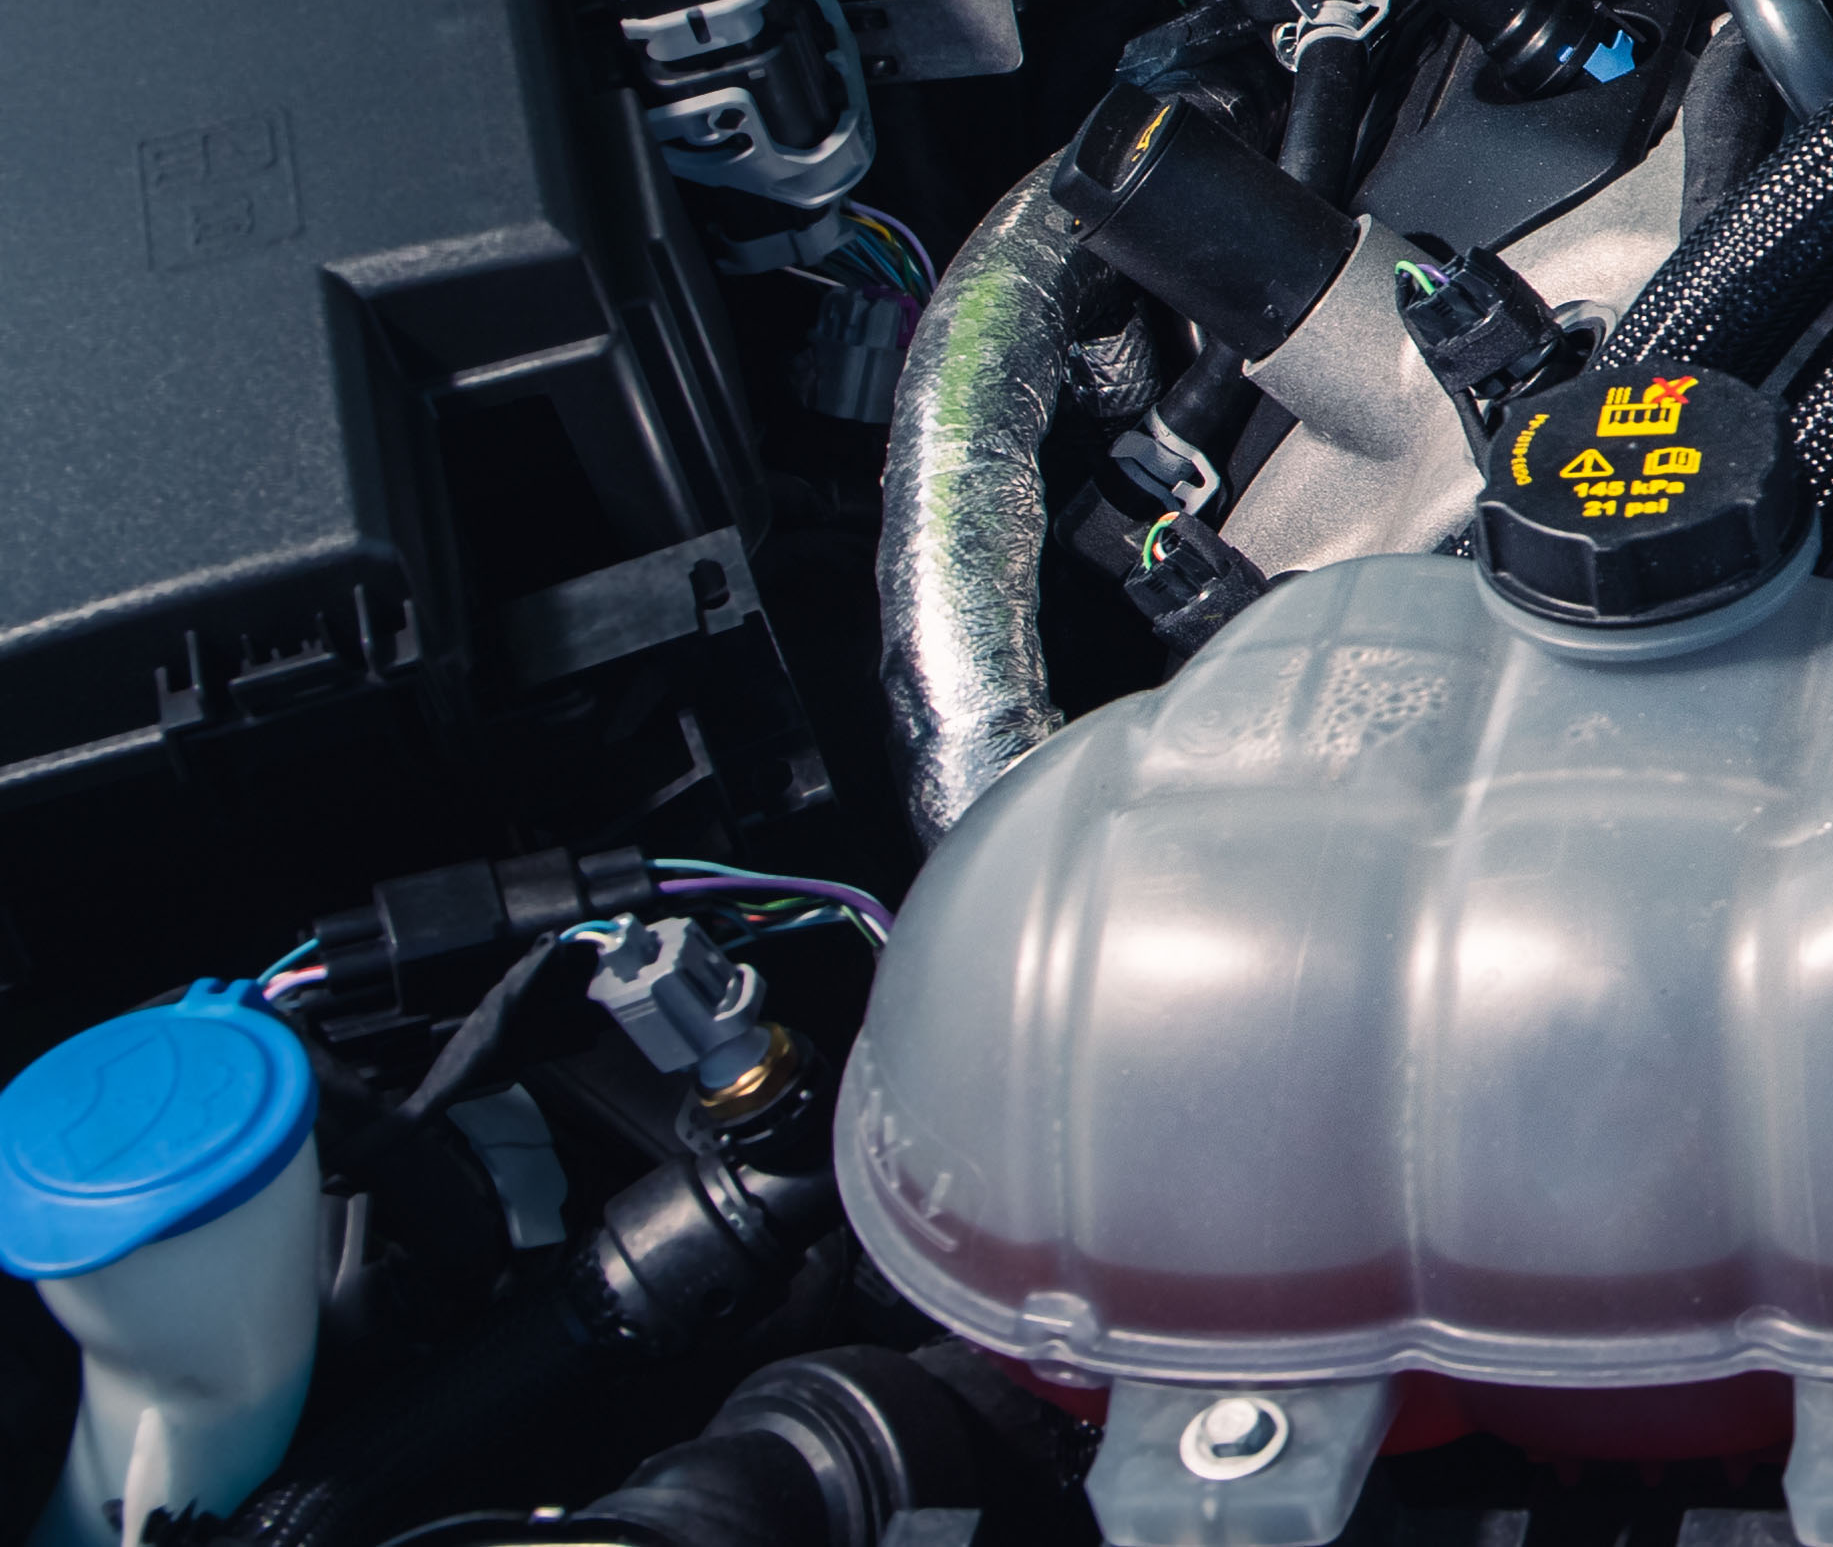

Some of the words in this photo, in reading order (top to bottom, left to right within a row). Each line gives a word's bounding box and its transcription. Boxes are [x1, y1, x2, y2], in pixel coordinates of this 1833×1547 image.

[1572, 481, 1625, 498] 145
[1630, 479, 1685, 496] kPa
[1582, 501, 1617, 518] 21
[1623, 498, 1669, 518] psi
